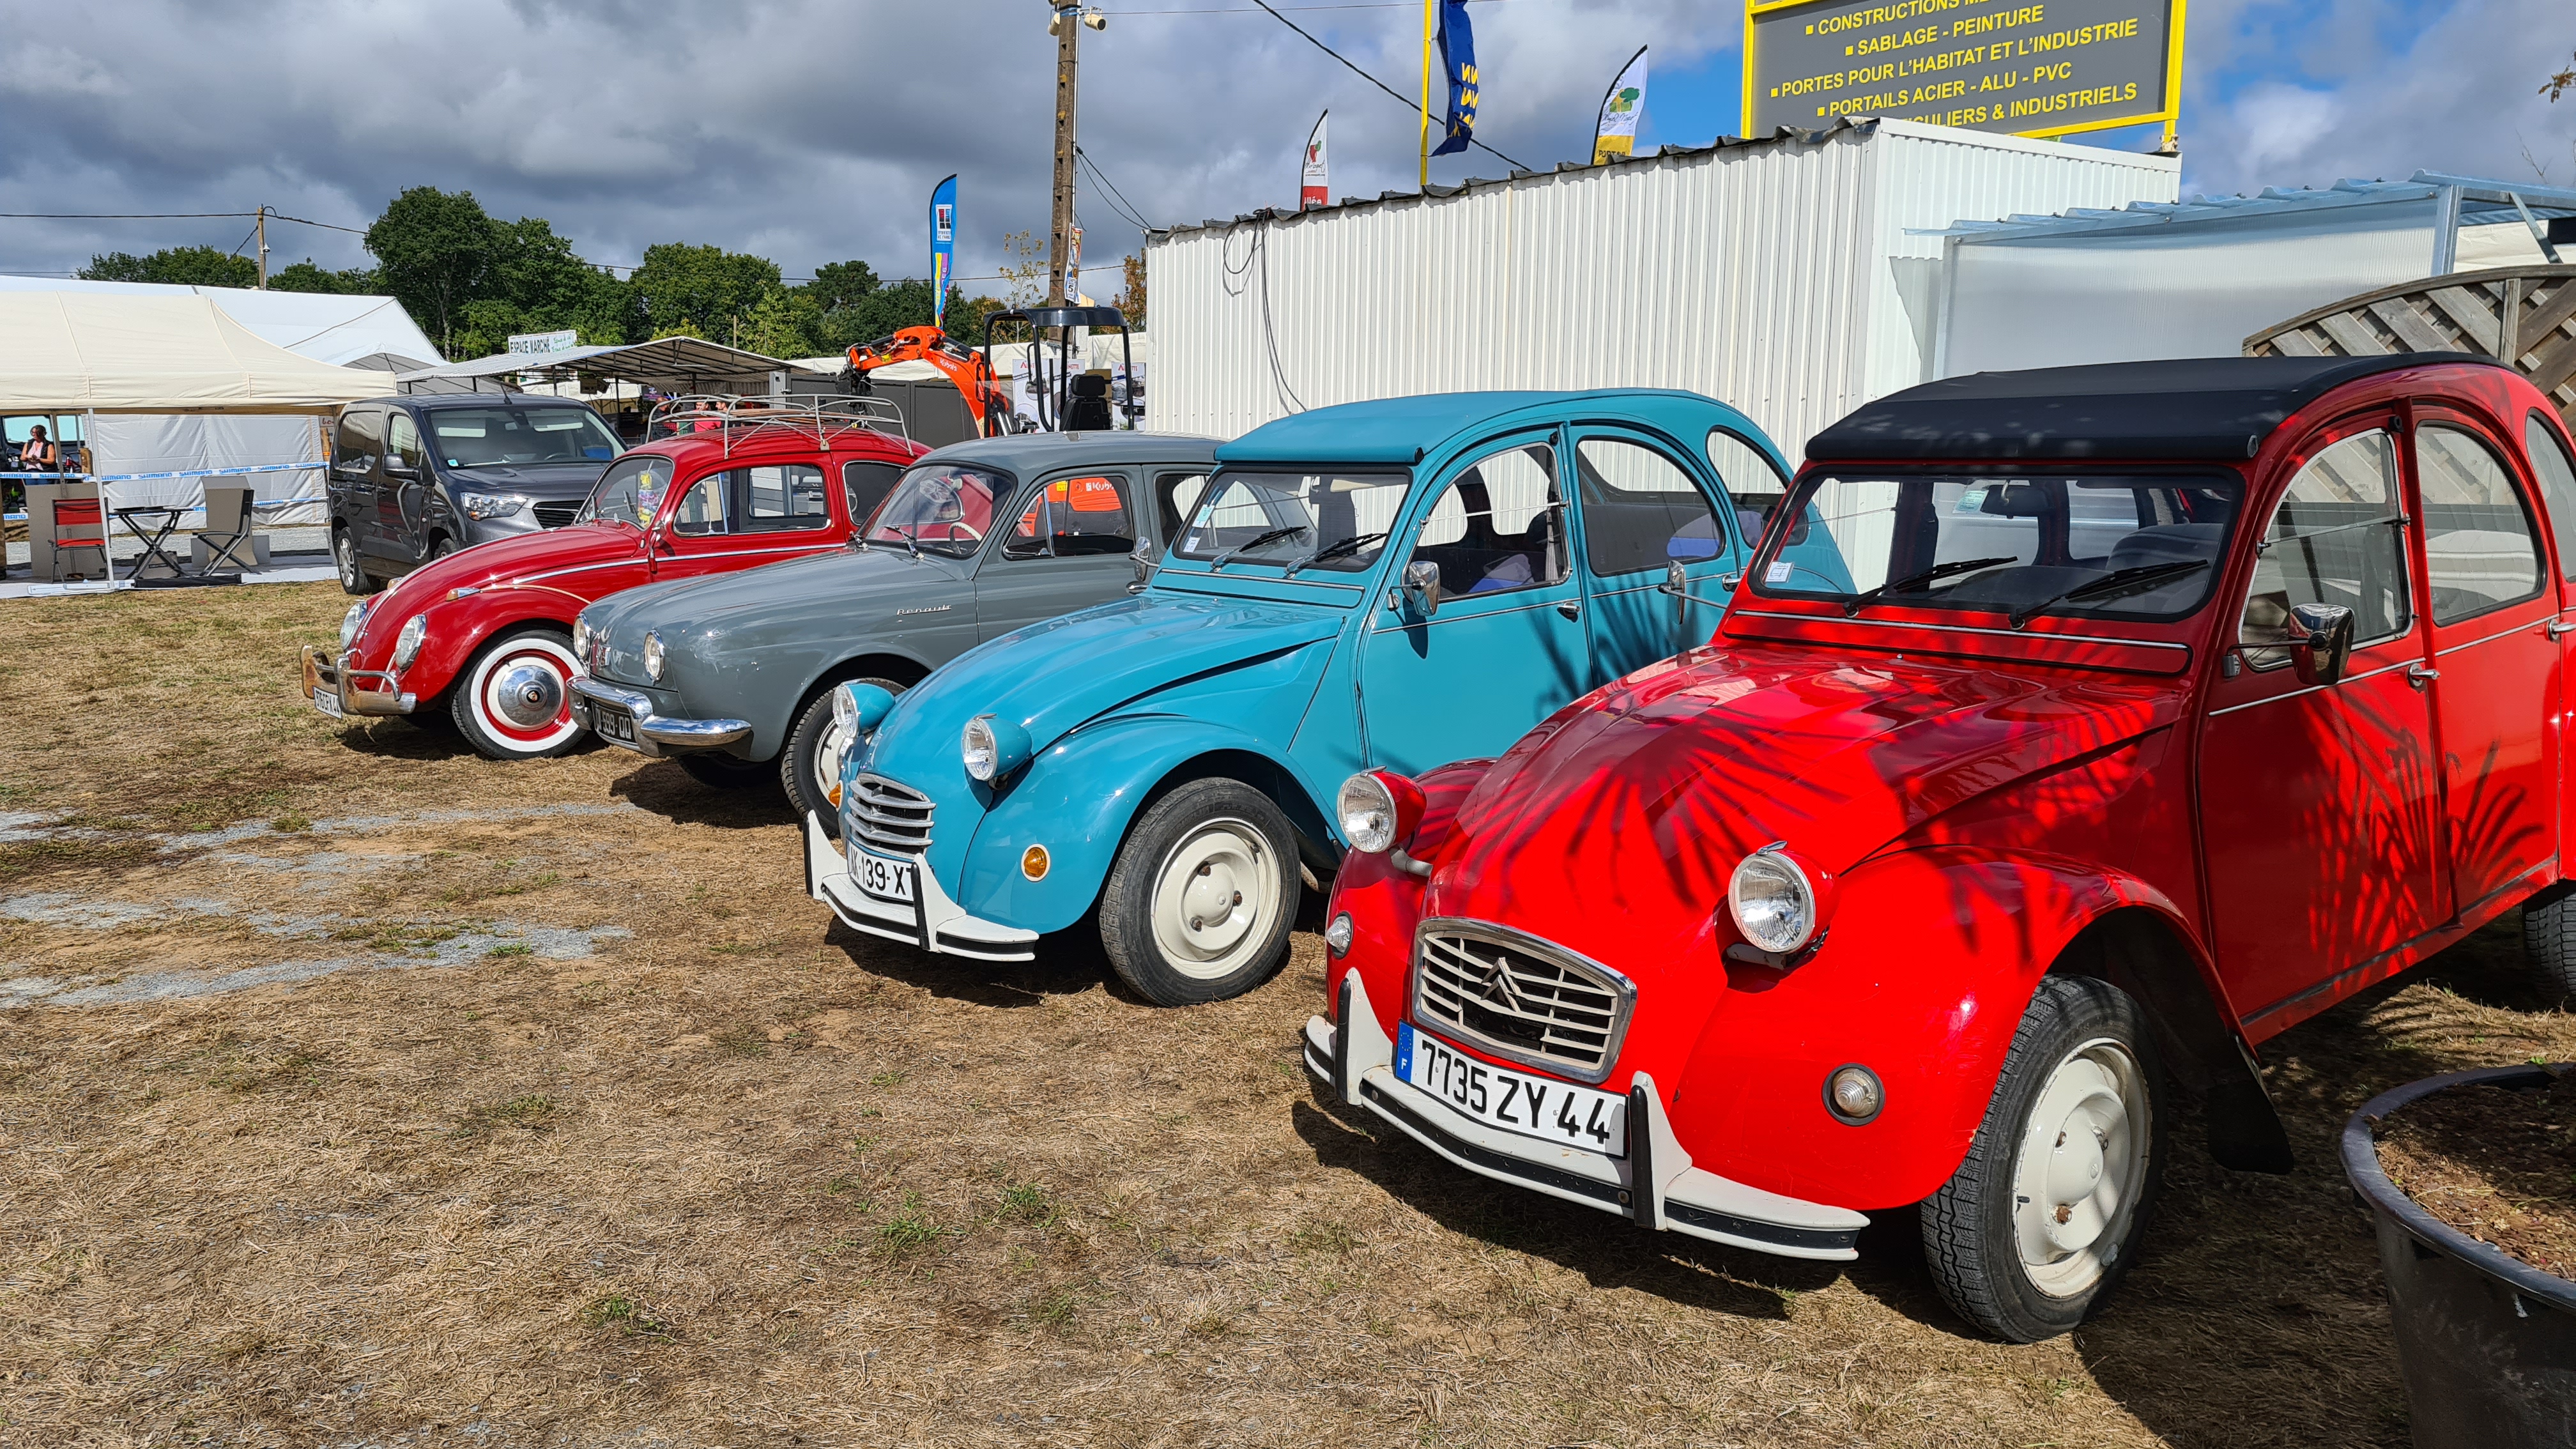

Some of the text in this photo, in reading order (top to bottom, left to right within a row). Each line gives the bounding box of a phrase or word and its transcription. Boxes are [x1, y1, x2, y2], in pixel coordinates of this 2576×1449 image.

[1858, 26, 1938, 56] SABLAGE
[1953, 5, 2044, 38] PEINTURE
[1782, 19, 2138, 97] PORTES POUR L'HABITAT ET L'INDUSTRIE
[1829, 90, 1908, 117] PORTAILS
[1912, 80, 1965, 103] ACIER
[1979, 72, 2016, 93] ALU
[2034, 62, 2071, 84] PVC
[1992, 103, 2005, 120] &
[2011, 82, 2137, 118] INDUSTRIELS
[510, 341, 528, 353] ESPACE
[940, 358, 957, 372] Kubota
[897, 604, 952, 615] Renault
[1400, 1058, 1407, 1070] F
[1422, 1039, 1610, 1144] 7735 ZY 44
